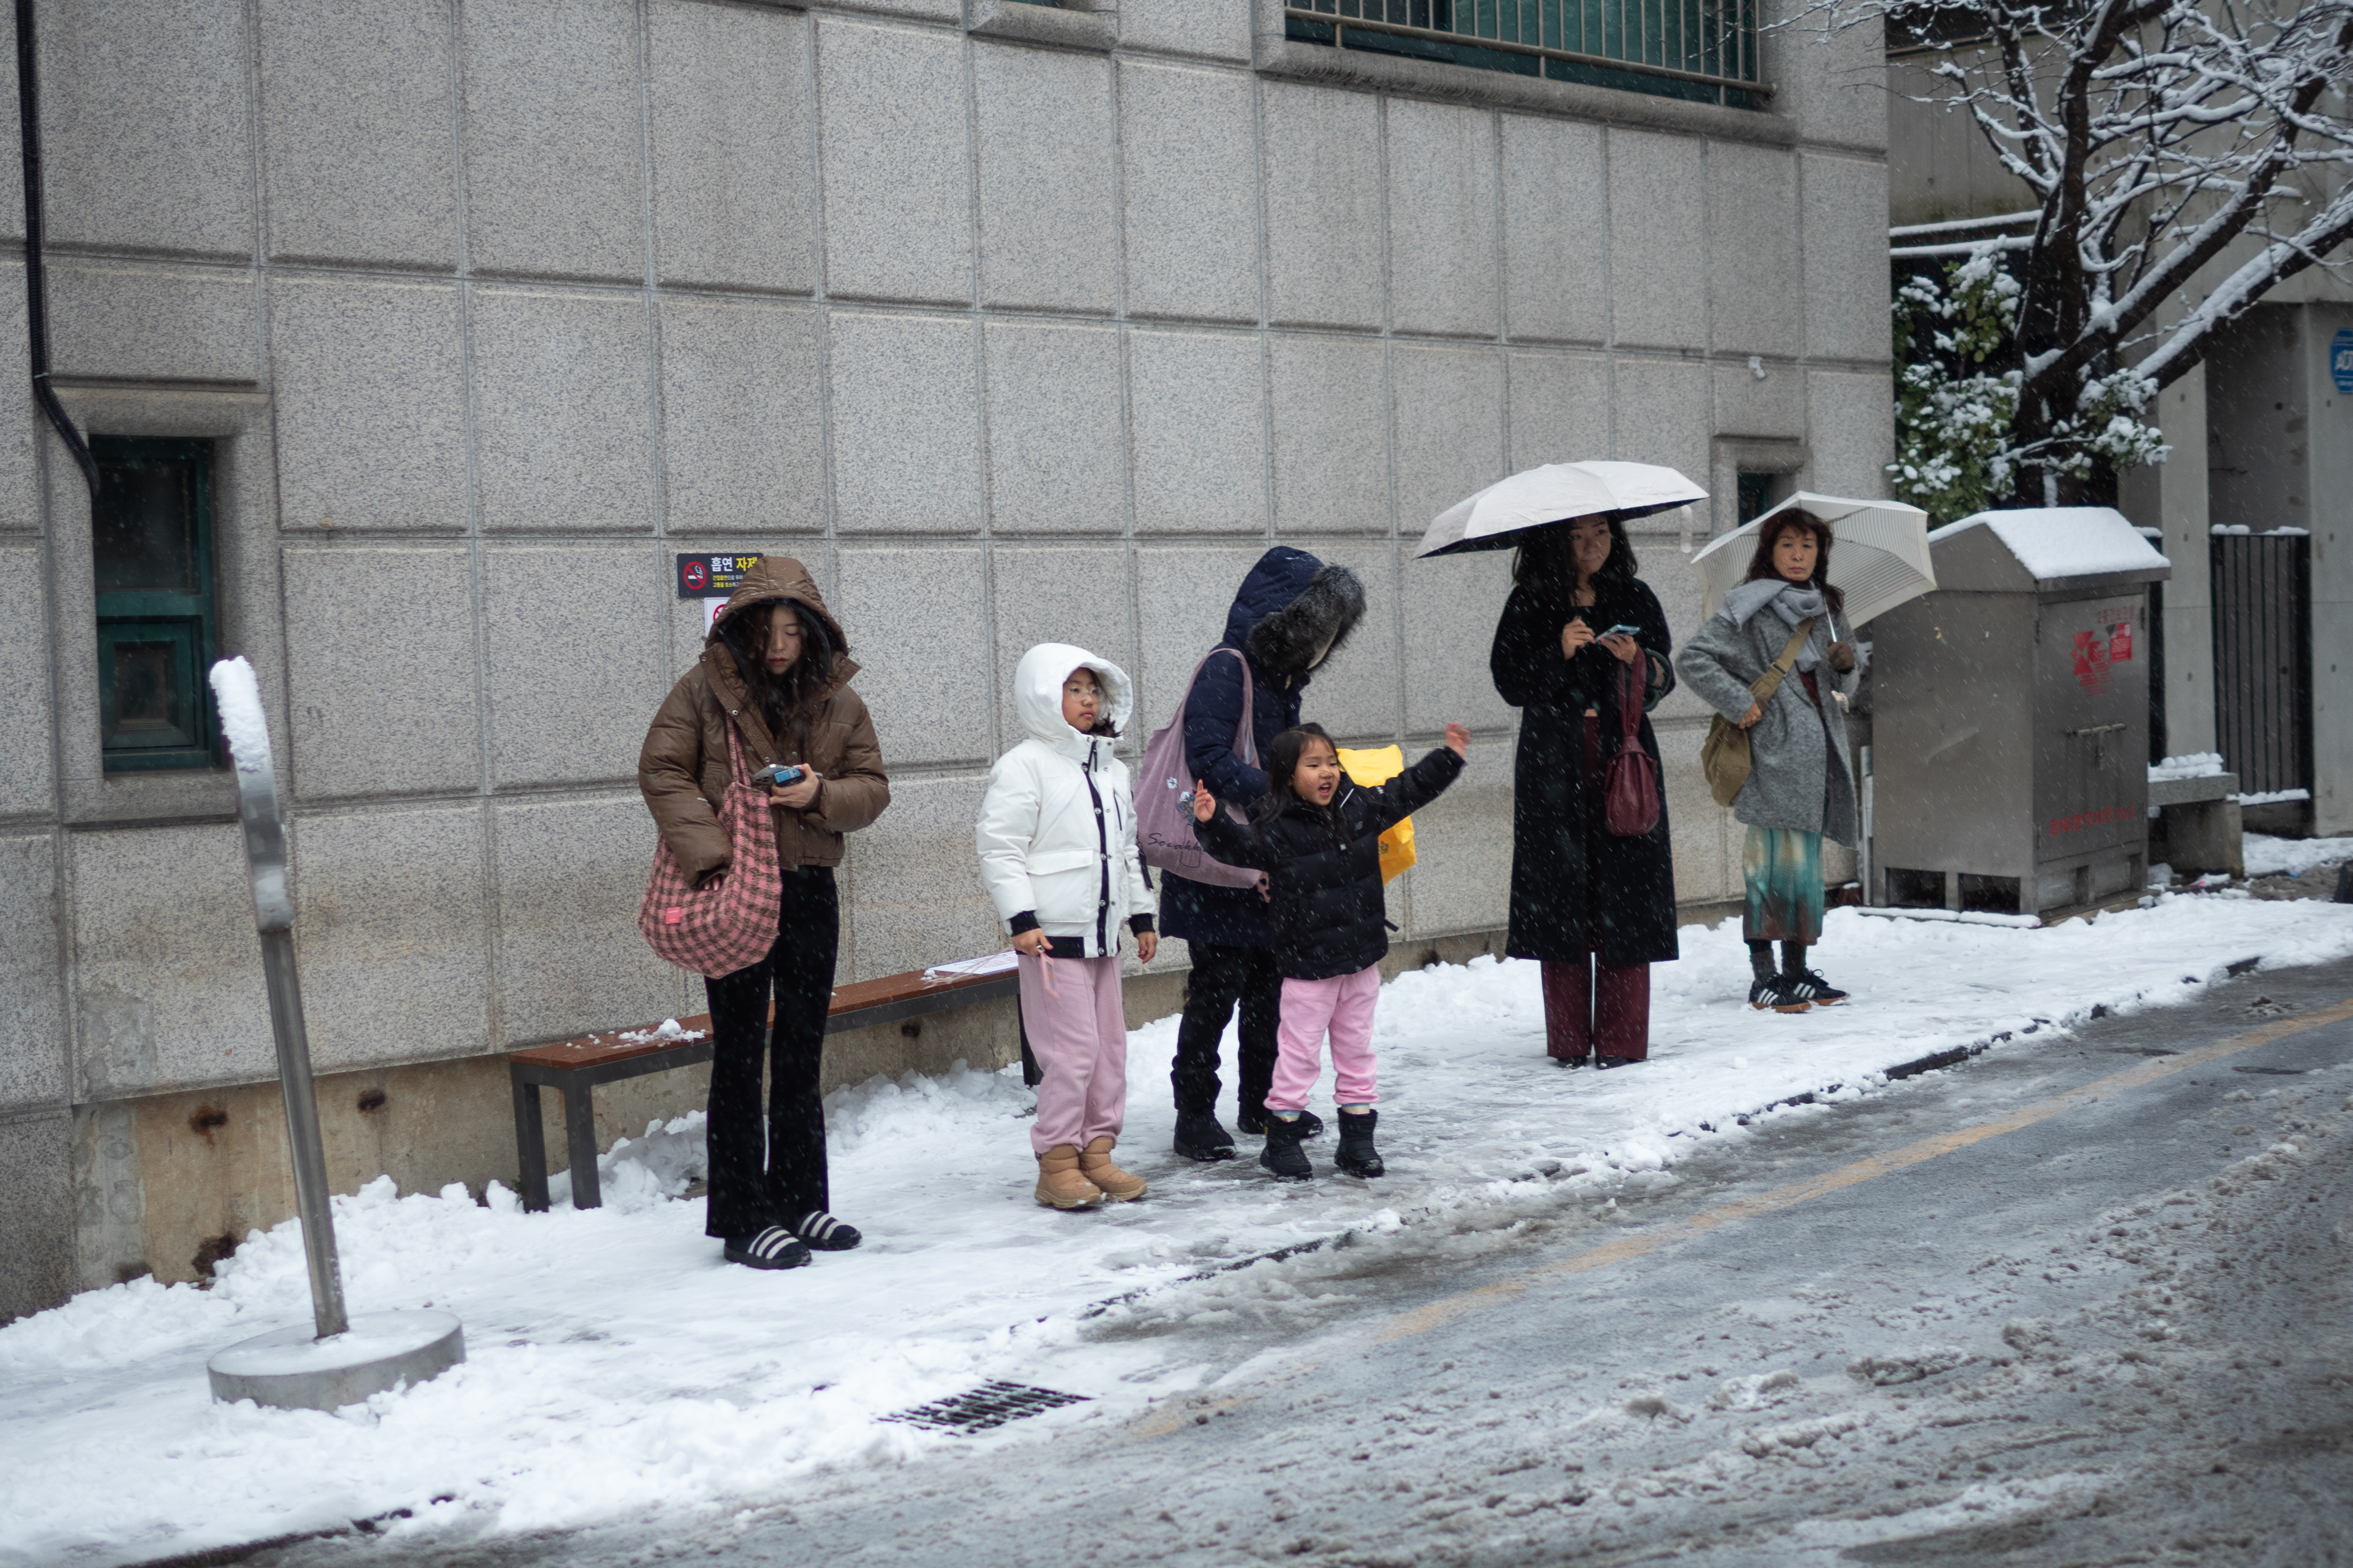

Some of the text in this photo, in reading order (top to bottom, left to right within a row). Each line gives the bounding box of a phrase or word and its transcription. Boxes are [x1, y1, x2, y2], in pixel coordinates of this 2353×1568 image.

[2334, 349, 2353, 371] AD
[711, 556, 758, 572] 흡연 자제
